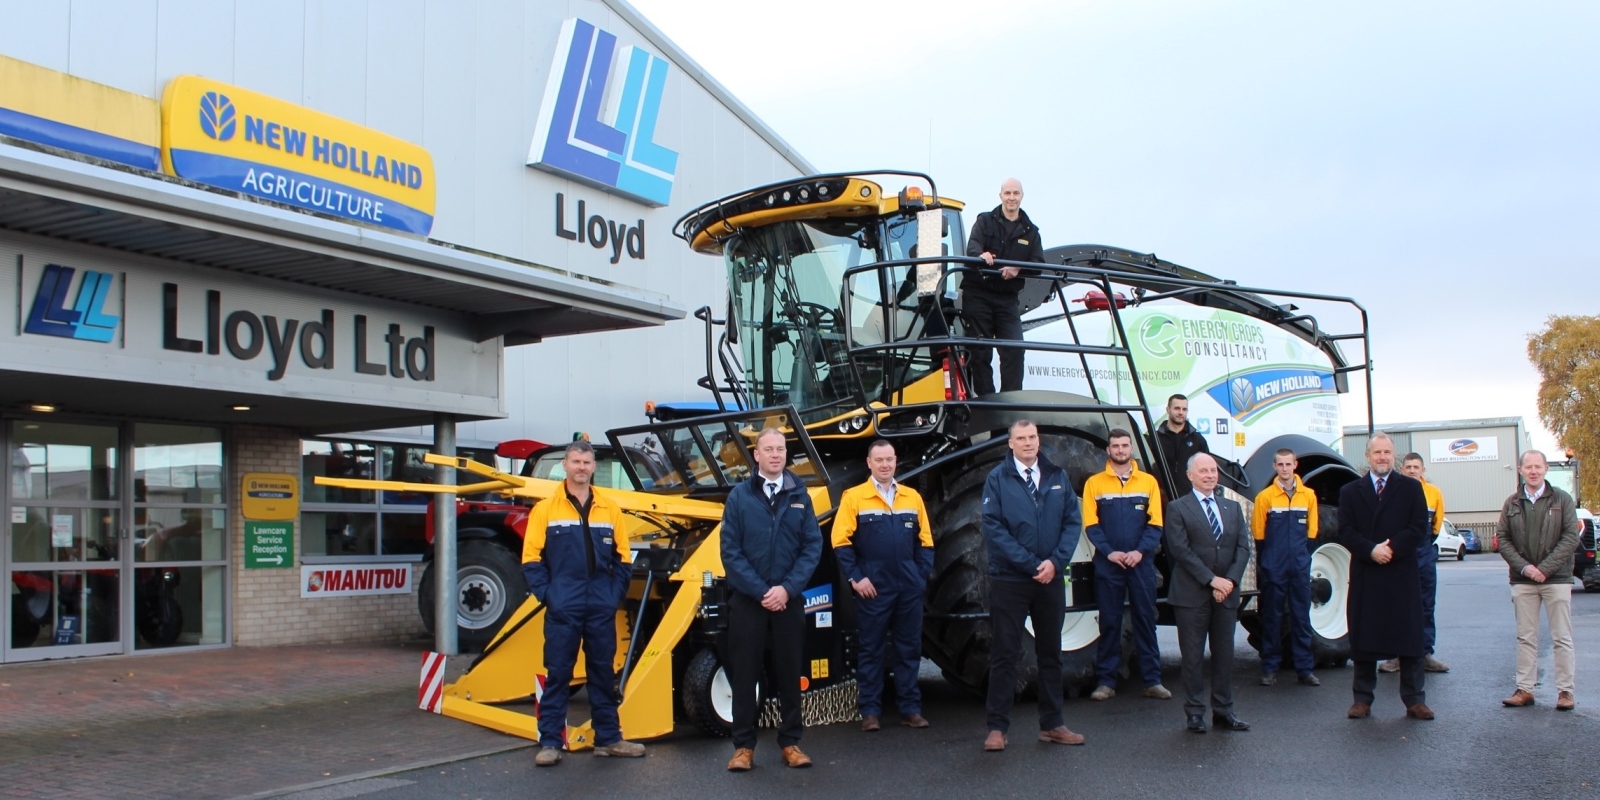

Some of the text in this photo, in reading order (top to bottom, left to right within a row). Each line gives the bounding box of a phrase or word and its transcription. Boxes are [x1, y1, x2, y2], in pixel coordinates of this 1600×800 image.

[245, 114, 422, 190] NEW HOLLAND
[242, 167, 384, 222] AGRICULTURE
[555, 192, 646, 264] Lloyd
[163, 282, 436, 382] Lloyd Ltd
[1182, 319, 1264, 345] ENERGY CROPS
[1184, 341, 1267, 361] CONSULTANCY
[1028, 365, 1181, 381] WWW.ENERGYCOPSCONSULANCY.COM
[1255, 376, 1321, 401] NEW HOLLAND
[253, 526, 287, 535] Lawncare
[257, 536, 283, 544] Service
[252, 545, 288, 555] Reception
[324, 568, 406, 591] MANITOU
[804, 594, 829, 608] LAND
